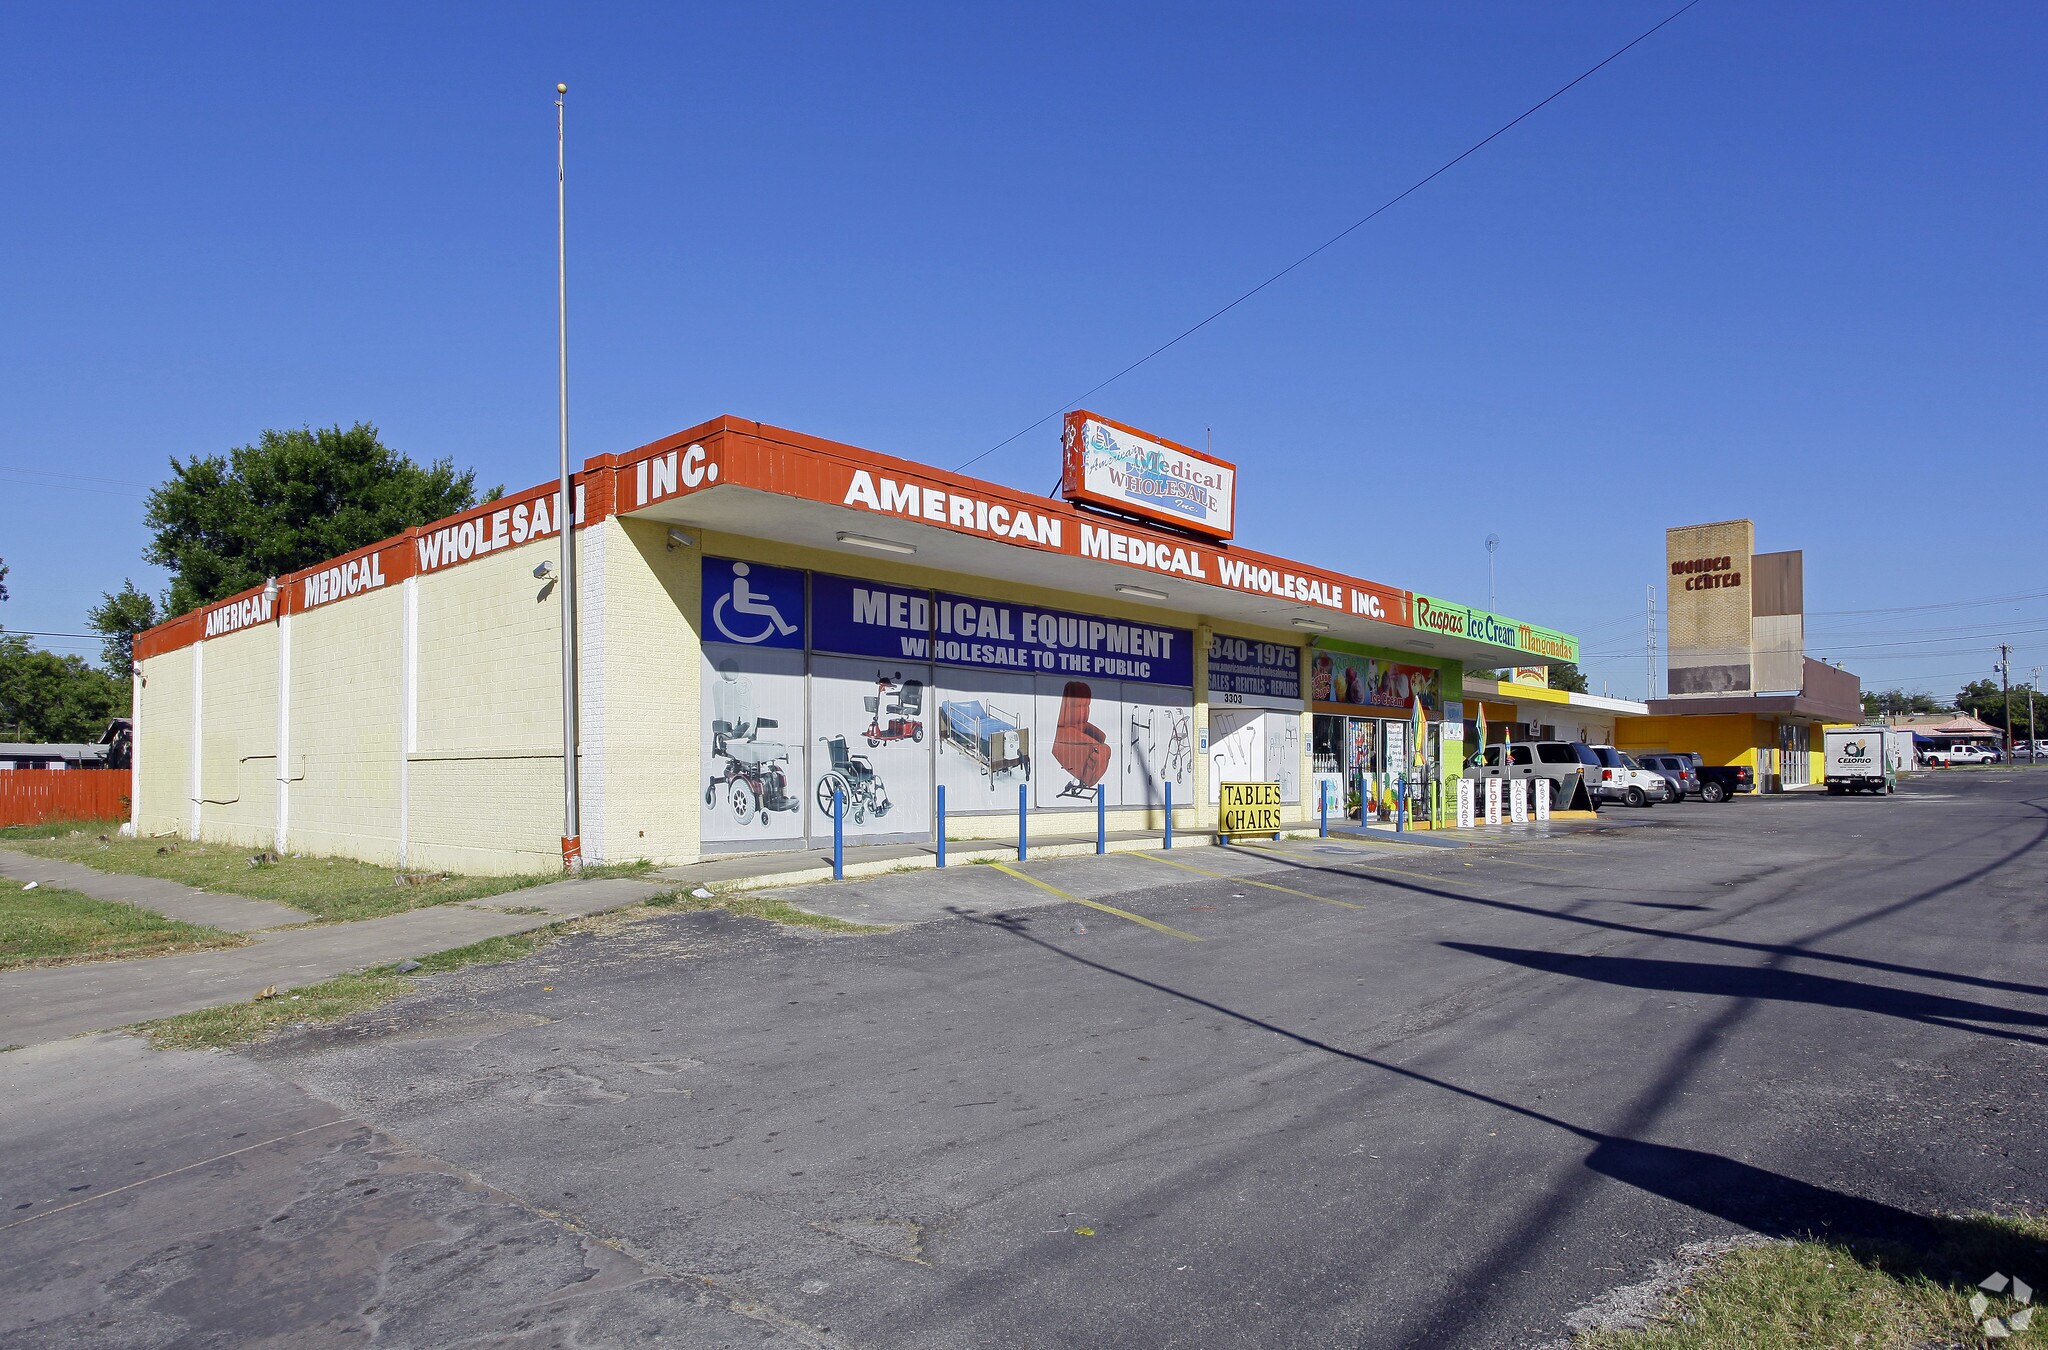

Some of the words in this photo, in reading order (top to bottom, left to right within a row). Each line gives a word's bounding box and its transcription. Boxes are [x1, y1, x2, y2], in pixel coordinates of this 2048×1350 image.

[1109, 466, 1218, 513] WHOLESALE
[1134, 446, 1223, 491] Medical
[1174, 500, 1198, 513] Inc.
[204, 592, 272, 638] AMERICAN
[303, 552, 385, 609] MEDICAL
[635, 444, 719, 506] INC.
[843, 470, 1062, 548] AMERICAN
[1080, 522, 1206, 579] MEDICAL
[1217, 556, 1343, 609] WHOLESALE
[1351, 588, 1386, 619] INC.
[1672, 556, 1731, 575] WONDER
[1685, 572, 1741, 591] CENTER
[852, 587, 1015, 641] MEDICAL
[1022, 611, 1174, 660] EQUIPMENT
[1416, 596, 1463, 635] Raspas
[1466, 609, 1485, 638] Ice
[1486, 615, 1516, 648] Cream
[1519, 623, 1573, 660] Mangonadas
[900, 636, 1028, 668] WHOLESALE
[1031, 649, 1054, 669] TO
[1058, 652, 1091, 672] THE
[1094, 656, 1151, 679] PUBLIC
[1208, 673, 1230, 691] SALES
[1235, 676, 1266, 695] RENTALS
[1270, 680, 1298, 698] REPAIRS
[1224, 693, 1243, 704] 3303
[1381, 692, 1405, 708] Cream
[1224, 785, 1280, 806] TABLES
[1460, 779, 1470, 828] MANGONADAS
[1489, 778, 1498, 824] ELOTES
[1514, 780, 1524, 822] NACHOS
[1225, 809, 1280, 831] CHAIRS
